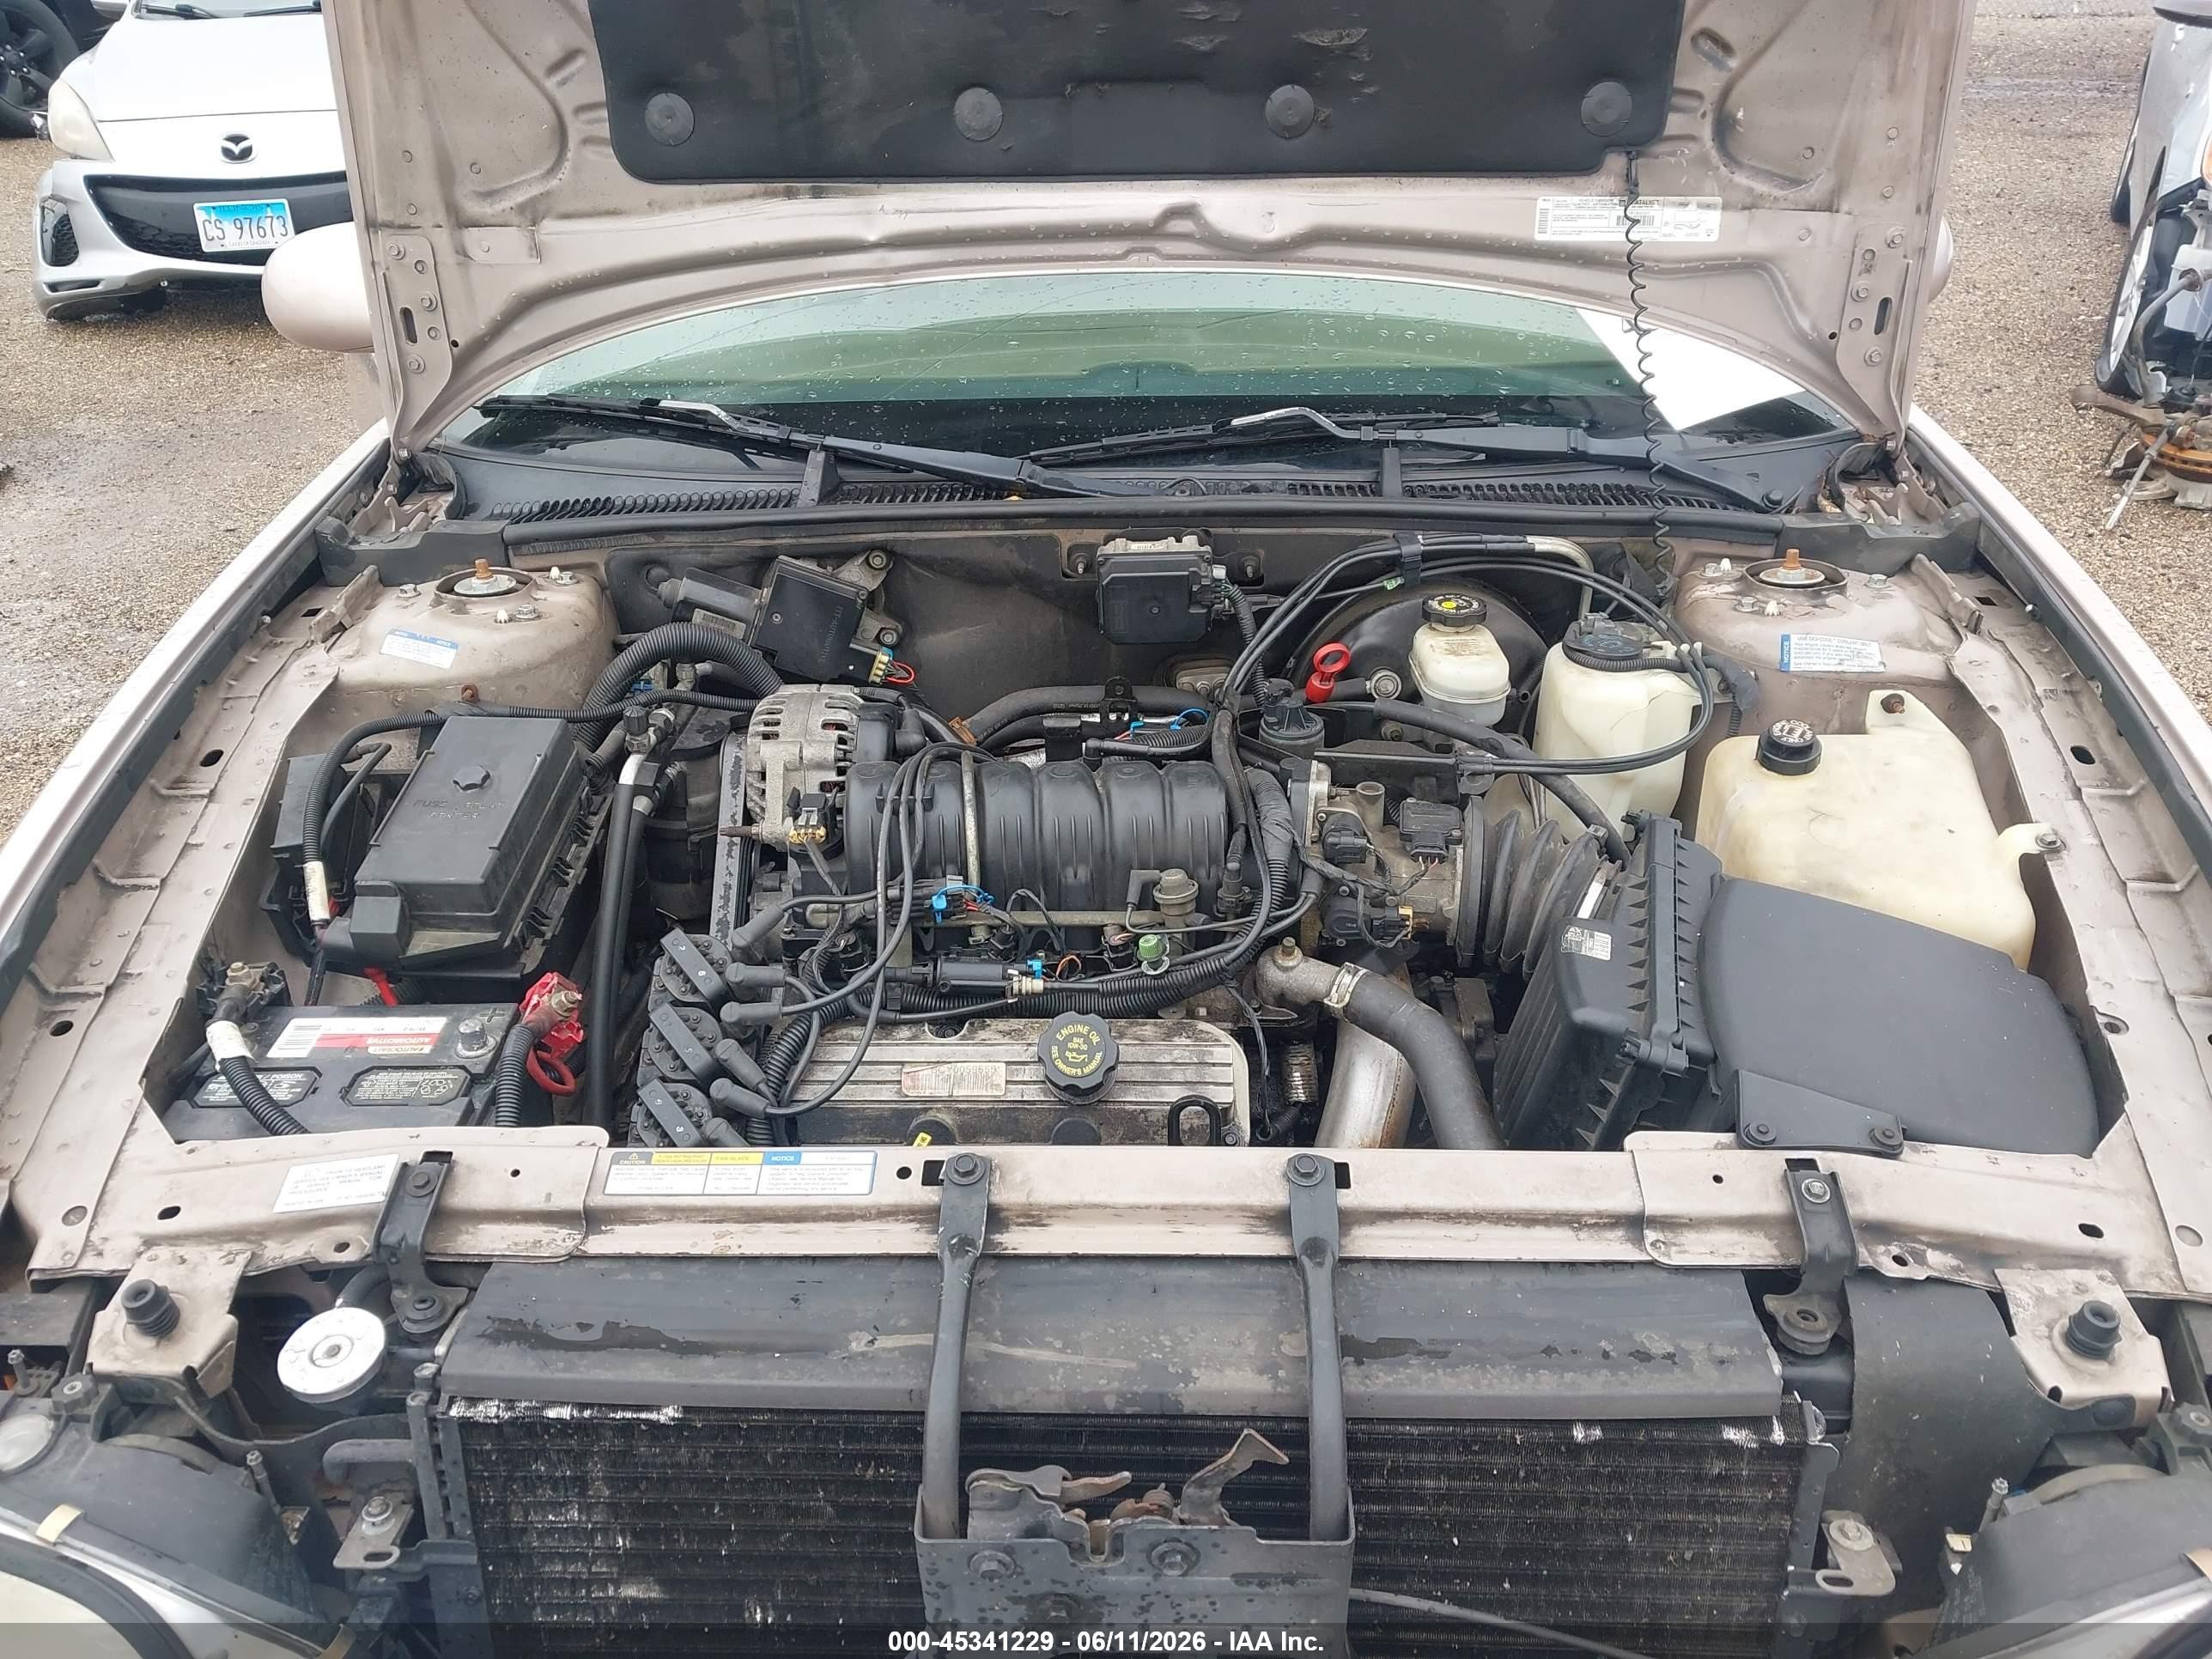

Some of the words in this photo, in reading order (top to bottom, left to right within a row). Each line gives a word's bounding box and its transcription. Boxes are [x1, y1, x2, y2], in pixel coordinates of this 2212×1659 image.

[203, 218, 226, 240] CS
[234, 216, 289, 240] 97673
[1771, 720, 1787, 736] ENGINE
[428, 811, 480, 820] CENTER
[1055, 1024, 1091, 1041] ENGINE
[1089, 1030, 1101, 1046] OIL
[1051, 1045, 1060, 1060] SEE
[1082, 1050, 1103, 1074] MANUAL
